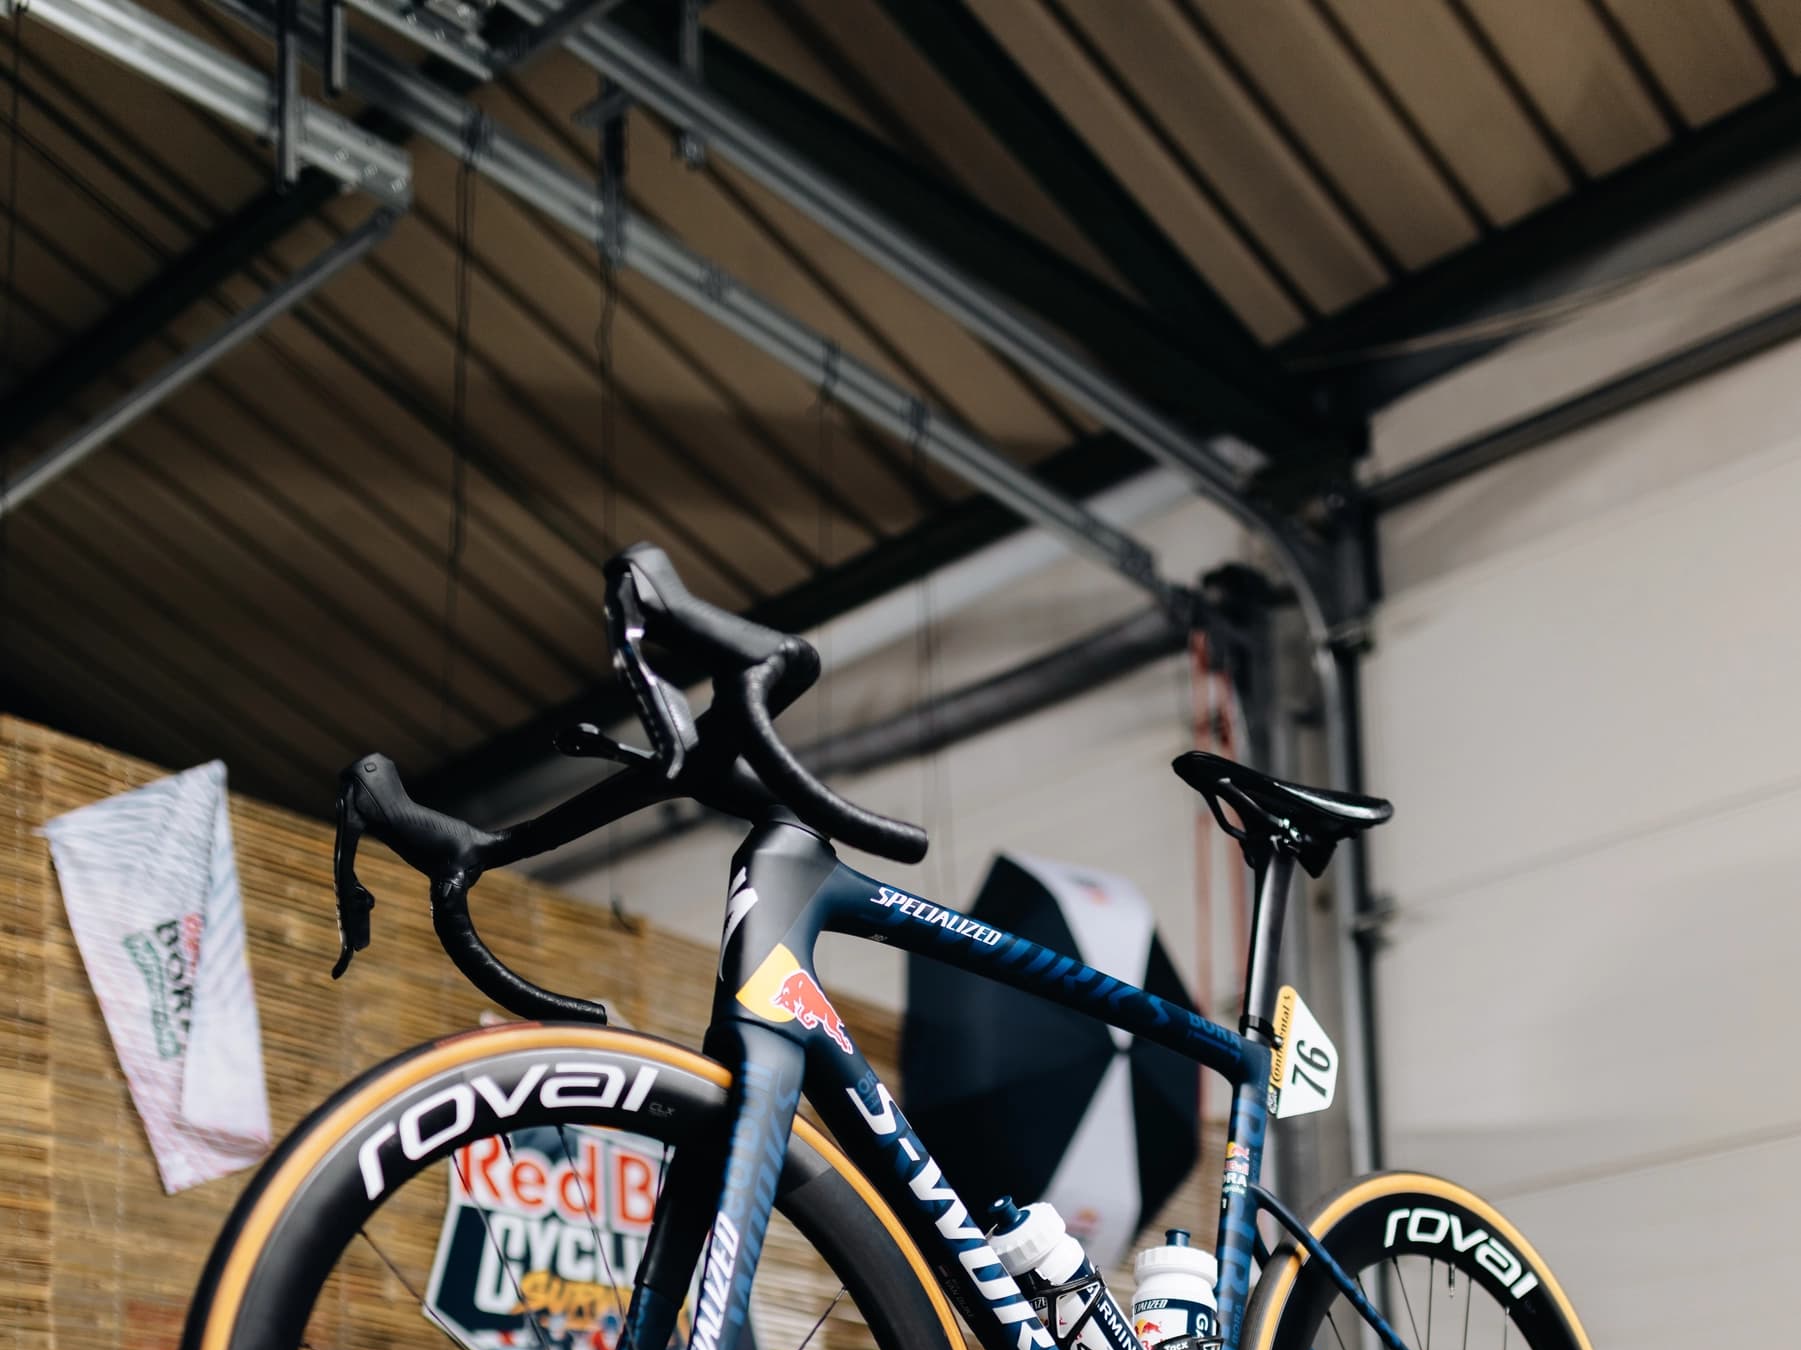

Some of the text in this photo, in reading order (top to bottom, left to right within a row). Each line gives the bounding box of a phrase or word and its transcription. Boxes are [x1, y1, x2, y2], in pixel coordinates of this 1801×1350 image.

[870, 886, 1003, 946] SPECIALIZED
[1271, 1004, 1290, 1082] Contental
[1291, 1039, 1331, 1098] 76
[357, 1063, 659, 1200] roval
[457, 1133, 597, 1213] Red
[1384, 1208, 1539, 1299] roval
